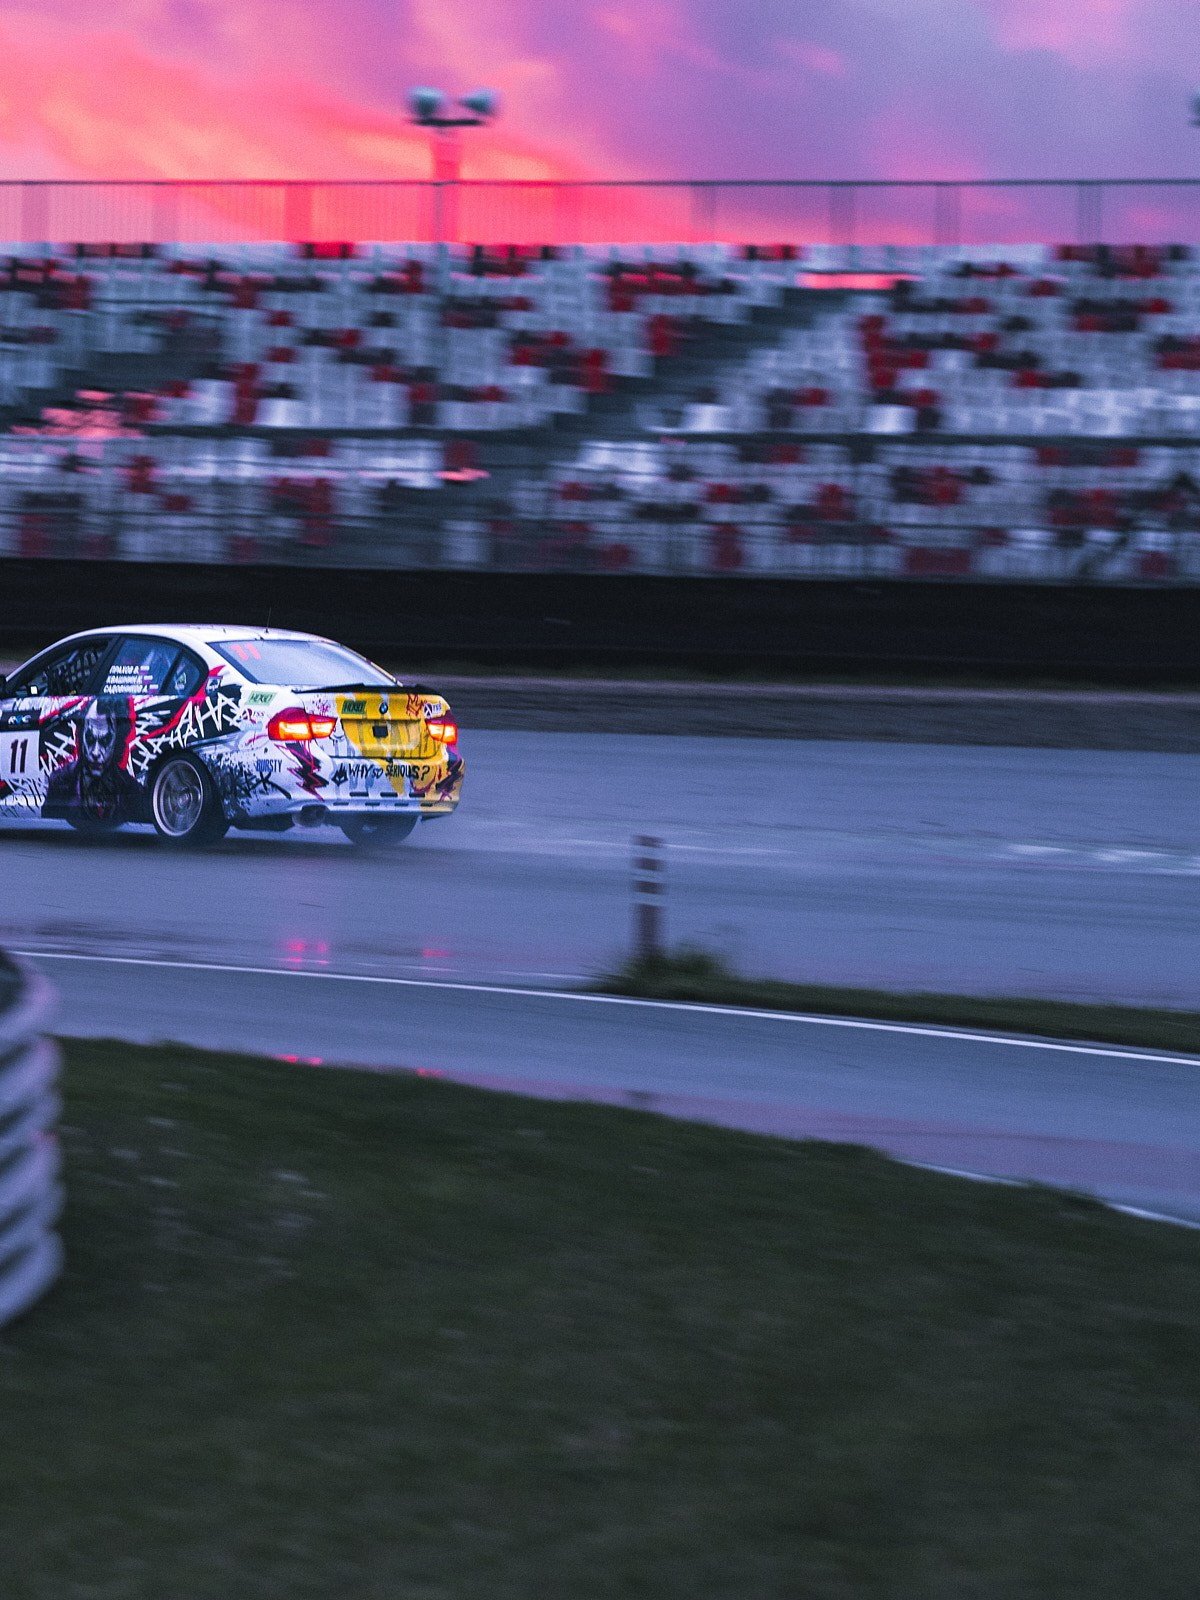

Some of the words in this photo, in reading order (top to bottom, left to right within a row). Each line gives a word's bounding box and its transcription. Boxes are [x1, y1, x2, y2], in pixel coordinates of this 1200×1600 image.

[229, 642, 262, 661] 11
[10, 738, 29, 775] 11
[348, 762, 373, 779] WHY
